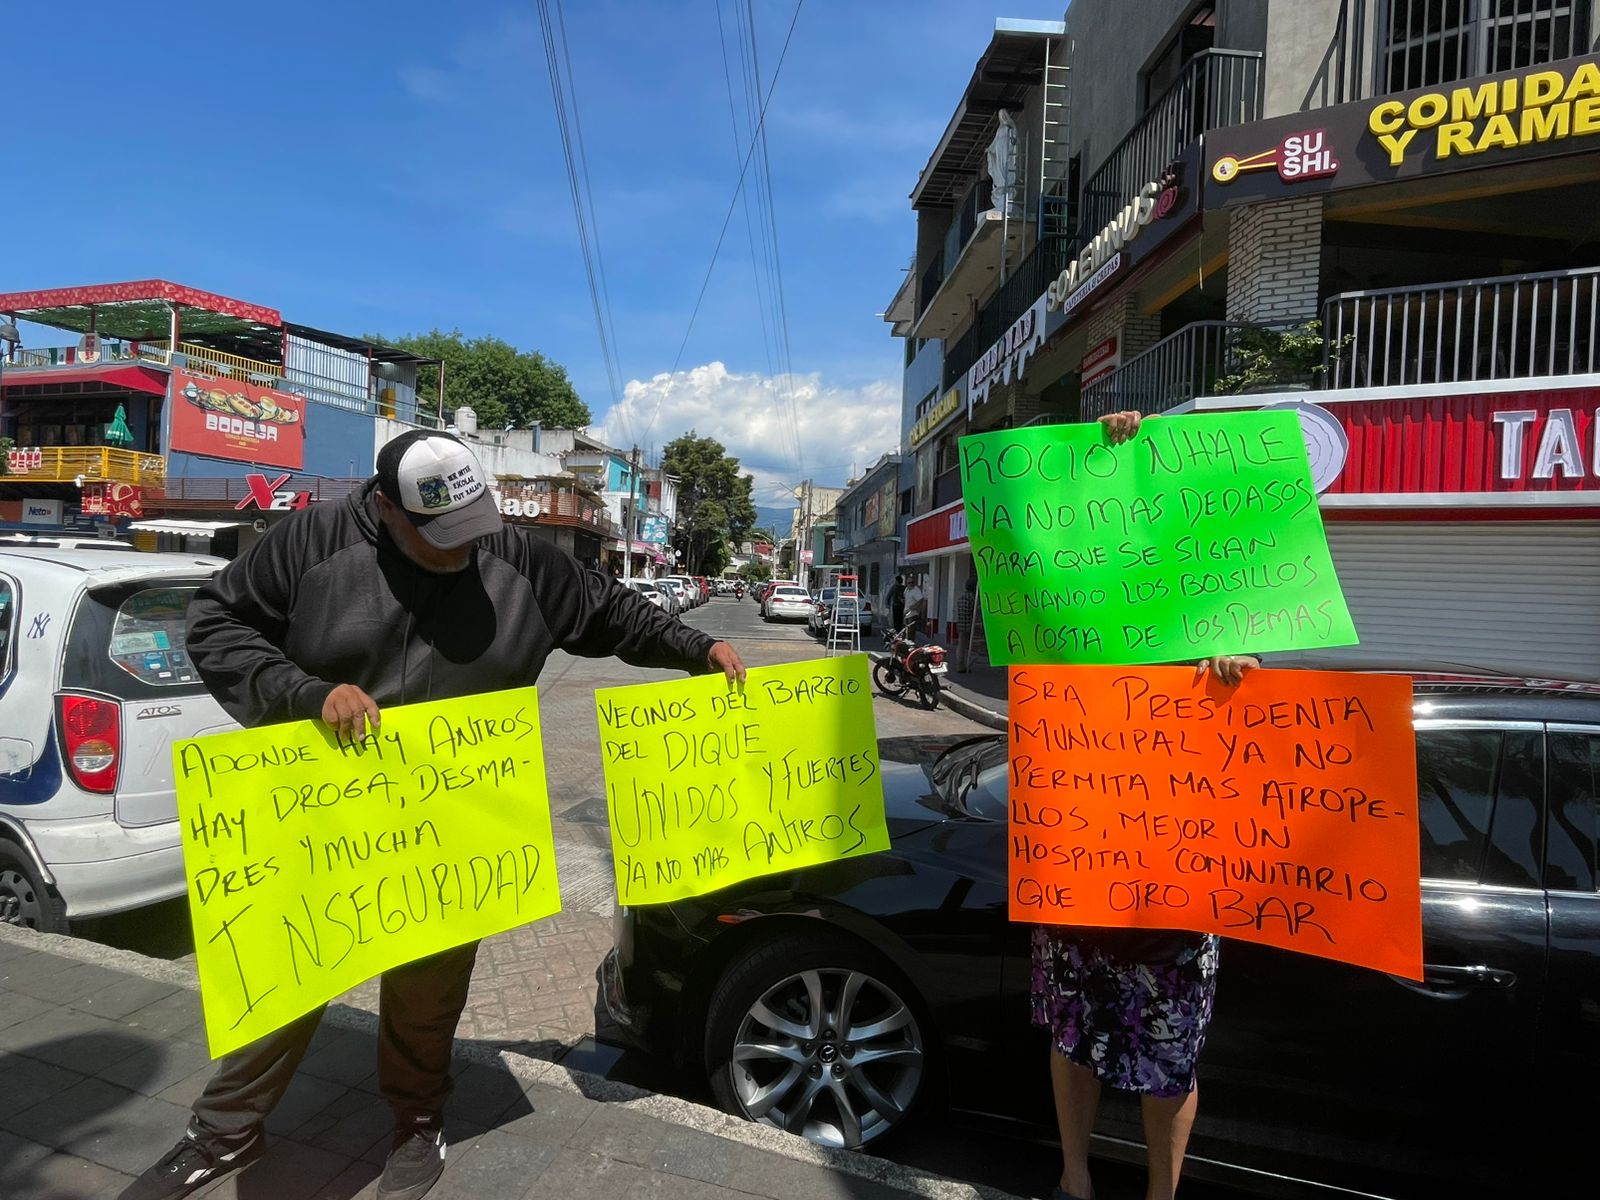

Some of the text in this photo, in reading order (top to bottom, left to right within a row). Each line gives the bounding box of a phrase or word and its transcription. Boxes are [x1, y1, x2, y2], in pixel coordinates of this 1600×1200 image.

[1368, 62, 1600, 136] COMIDA
[1283, 131, 1324, 156] SU
[1376, 97, 1600, 167] Y RAME
[1282, 150, 1338, 176] SHI.
[206, 413, 278, 442] BODEGA
[962, 426, 1299, 485] ROCIO NHALE
[1493, 406, 1600, 479] TA
[970, 498, 1013, 536] YA
[1026, 499, 1076, 531] NO
[1087, 491, 1165, 535] MAS
[977, 530, 1277, 580] PARA QUE SE SIGAN
[984, 555, 1318, 616] LLENANDO LOS BOLSILLOS
[1007, 600, 1334, 657] A COSTA DE LOS DEMAS
[137, 704, 182, 717] ATOS
[598, 676, 860, 728] VECINOS DEL BARRIO
[1012, 671, 1374, 732] SRA PRESIDENTA
[180, 706, 534, 798] ADONDE HAY ANTROS
[606, 723, 767, 772] DEL DIQUE
[1014, 718, 1353, 773] MUNICIPAL YA NO
[610, 748, 876, 848] UNIDOS Y FUERTES
[1011, 755, 1148, 800] PERMITA
[1169, 771, 1241, 799] MAS
[191, 803, 248, 855] HAY
[269, 772, 406, 823] DROGA,
[1119, 810, 1217, 852] MEJOR
[1234, 818, 1290, 850] UN
[194, 819, 442, 906] DRES Y MUCHA
[621, 803, 868, 898] YA NO MAS ANTROS
[1013, 835, 1388, 902] HOSPITAL COMUNITARIO
[1016, 877, 1337, 945] QUE OTRO BAR
